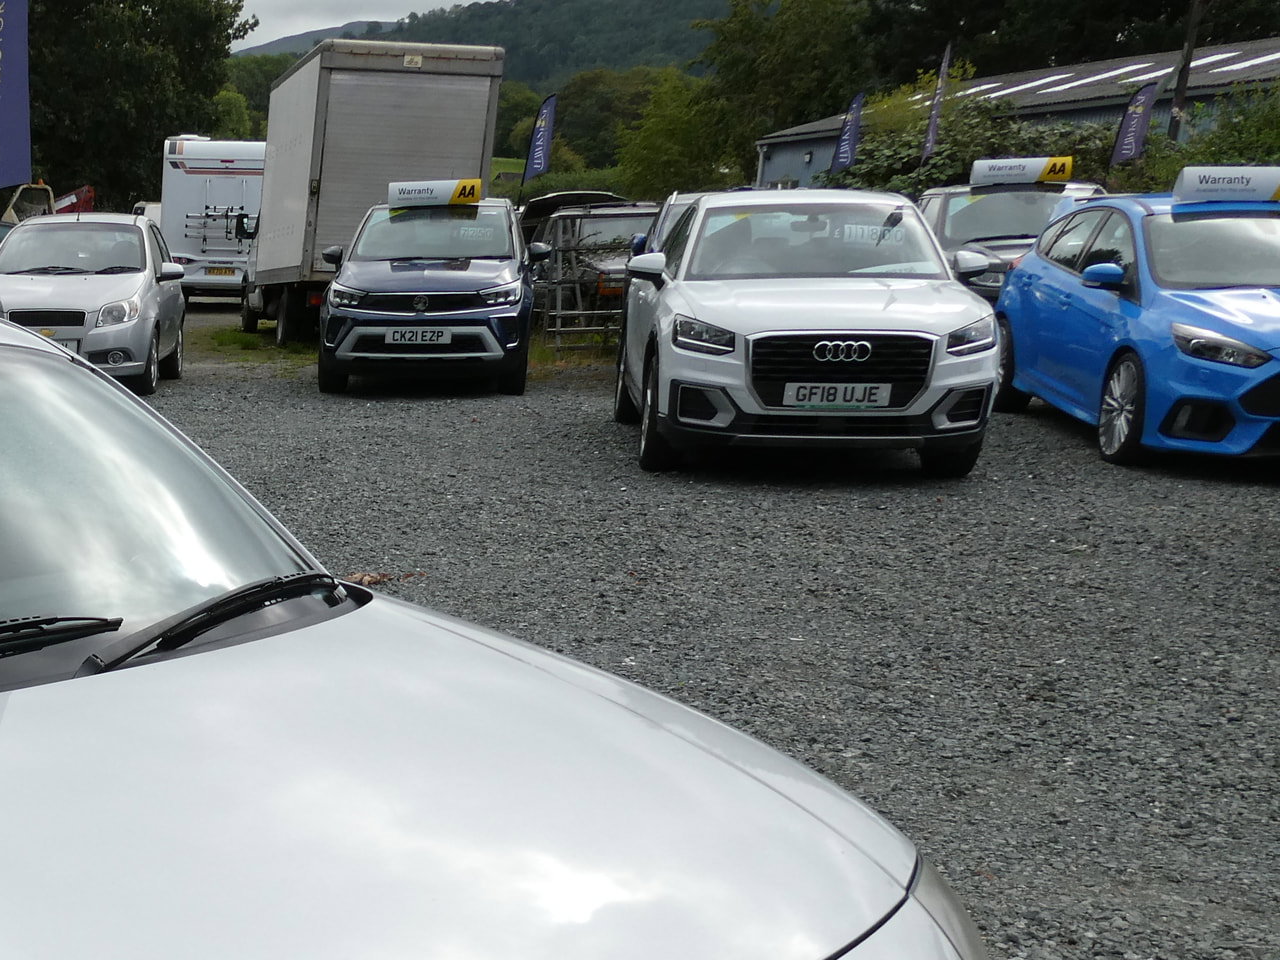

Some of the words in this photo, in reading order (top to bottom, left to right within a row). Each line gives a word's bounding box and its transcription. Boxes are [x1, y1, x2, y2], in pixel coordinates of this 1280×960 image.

[987, 164, 1027, 172] Warranty
[1047, 162, 1066, 175] AA
[1198, 174, 1252, 186] Warranty
[398, 187, 434, 196] Warranty
[457, 185, 475, 198] AA
[392, 330, 418, 342] CK21
[421, 330, 444, 342] EZP
[795, 385, 838, 403] GF18
[843, 386, 880, 403] UJE
